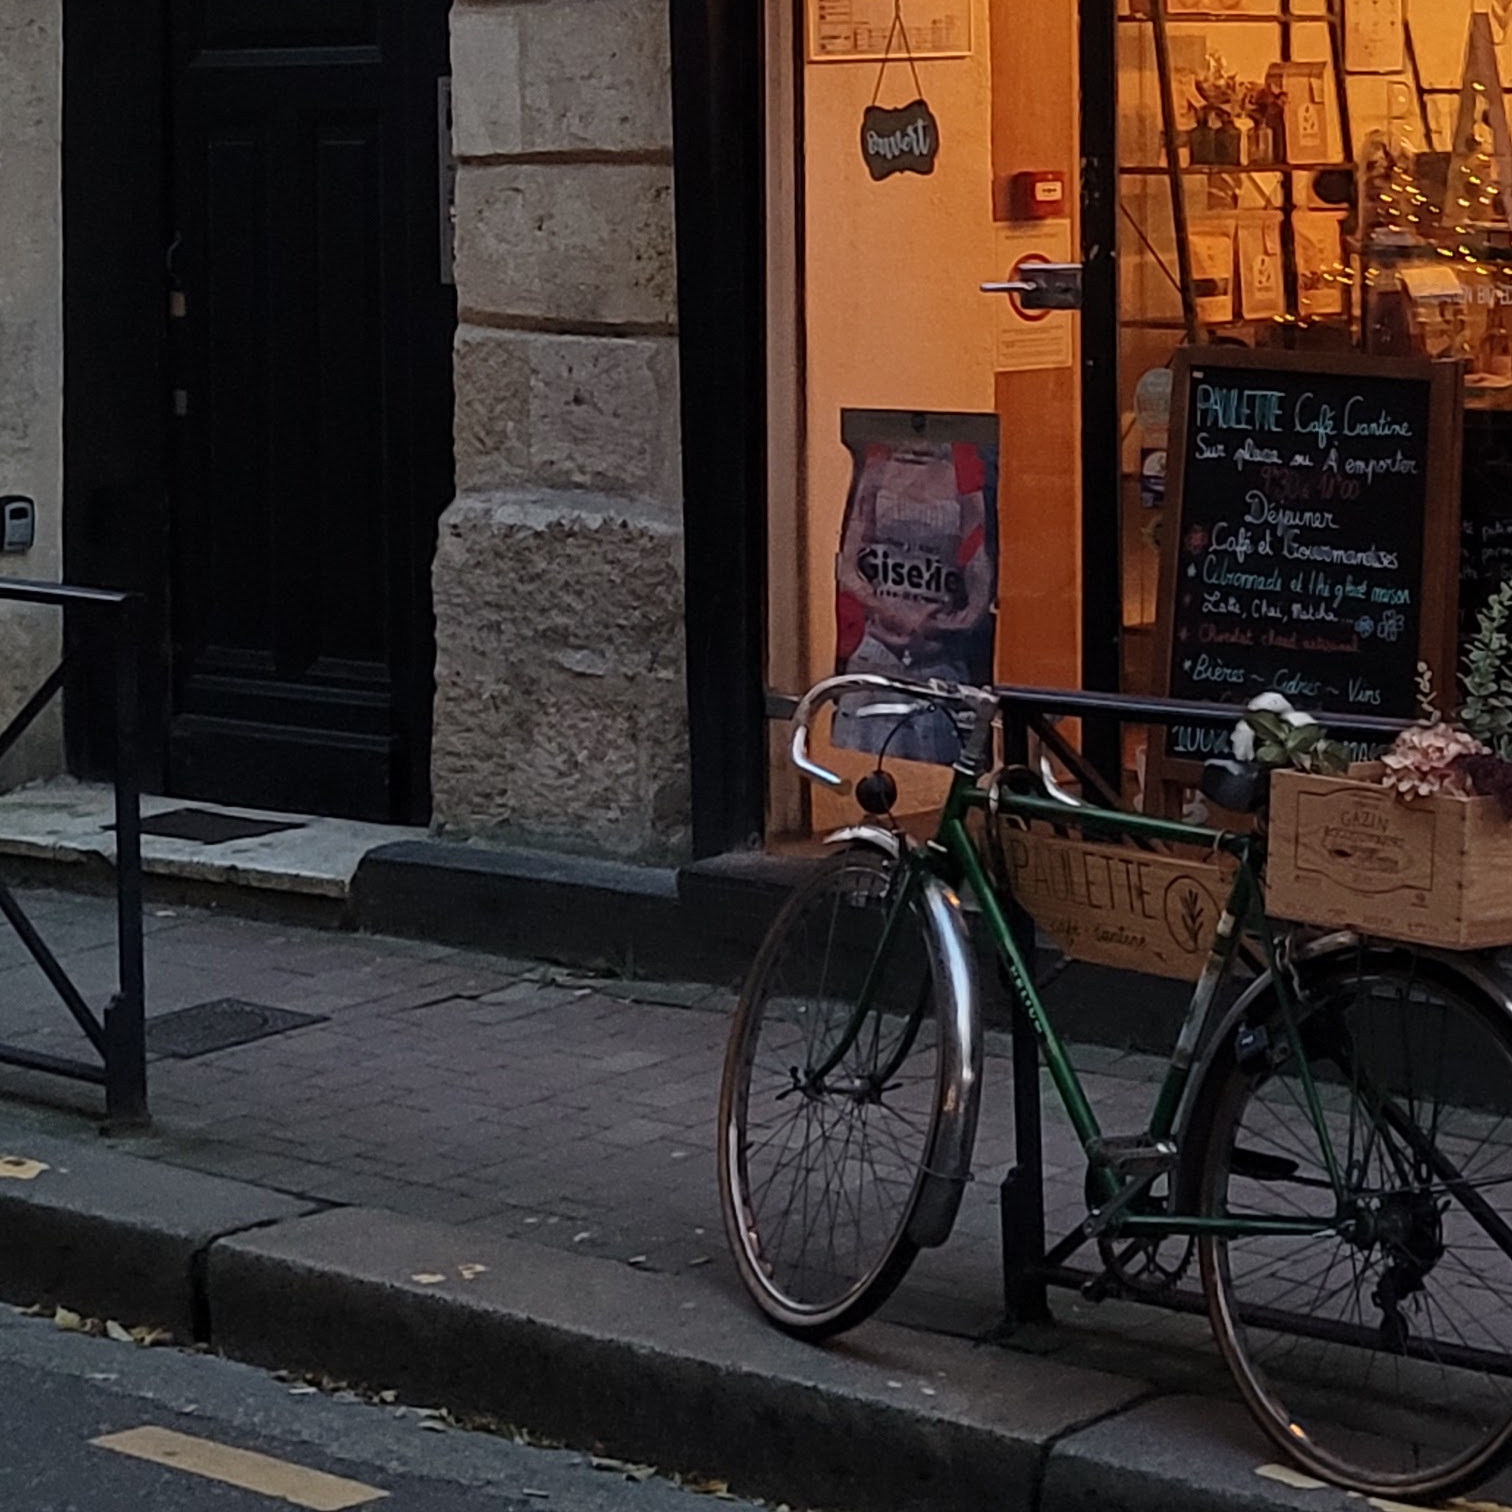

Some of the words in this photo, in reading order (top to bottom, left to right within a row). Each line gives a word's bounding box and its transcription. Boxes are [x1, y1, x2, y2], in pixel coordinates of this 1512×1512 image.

[1196, 384, 1286, 433] PAULETTE
[1293, 392, 1338, 449] Café
[1343, 395, 1413, 437] Cantine
[1195, 432, 1227, 460] Sur
[1345, 449, 1418, 485] emporter
[1243, 489, 1340, 537] Déjeuner
[1208, 521, 1254, 564] Café
[1257, 529, 1274, 556] et
[1191, 653, 1246, 684] Bières
[1271, 668, 1322, 696] Cidres
[1347, 676, 1382, 706] Vins
[1340, 810, 1390, 833] GAZIN
[1010, 838, 1158, 921] PAULETTE
